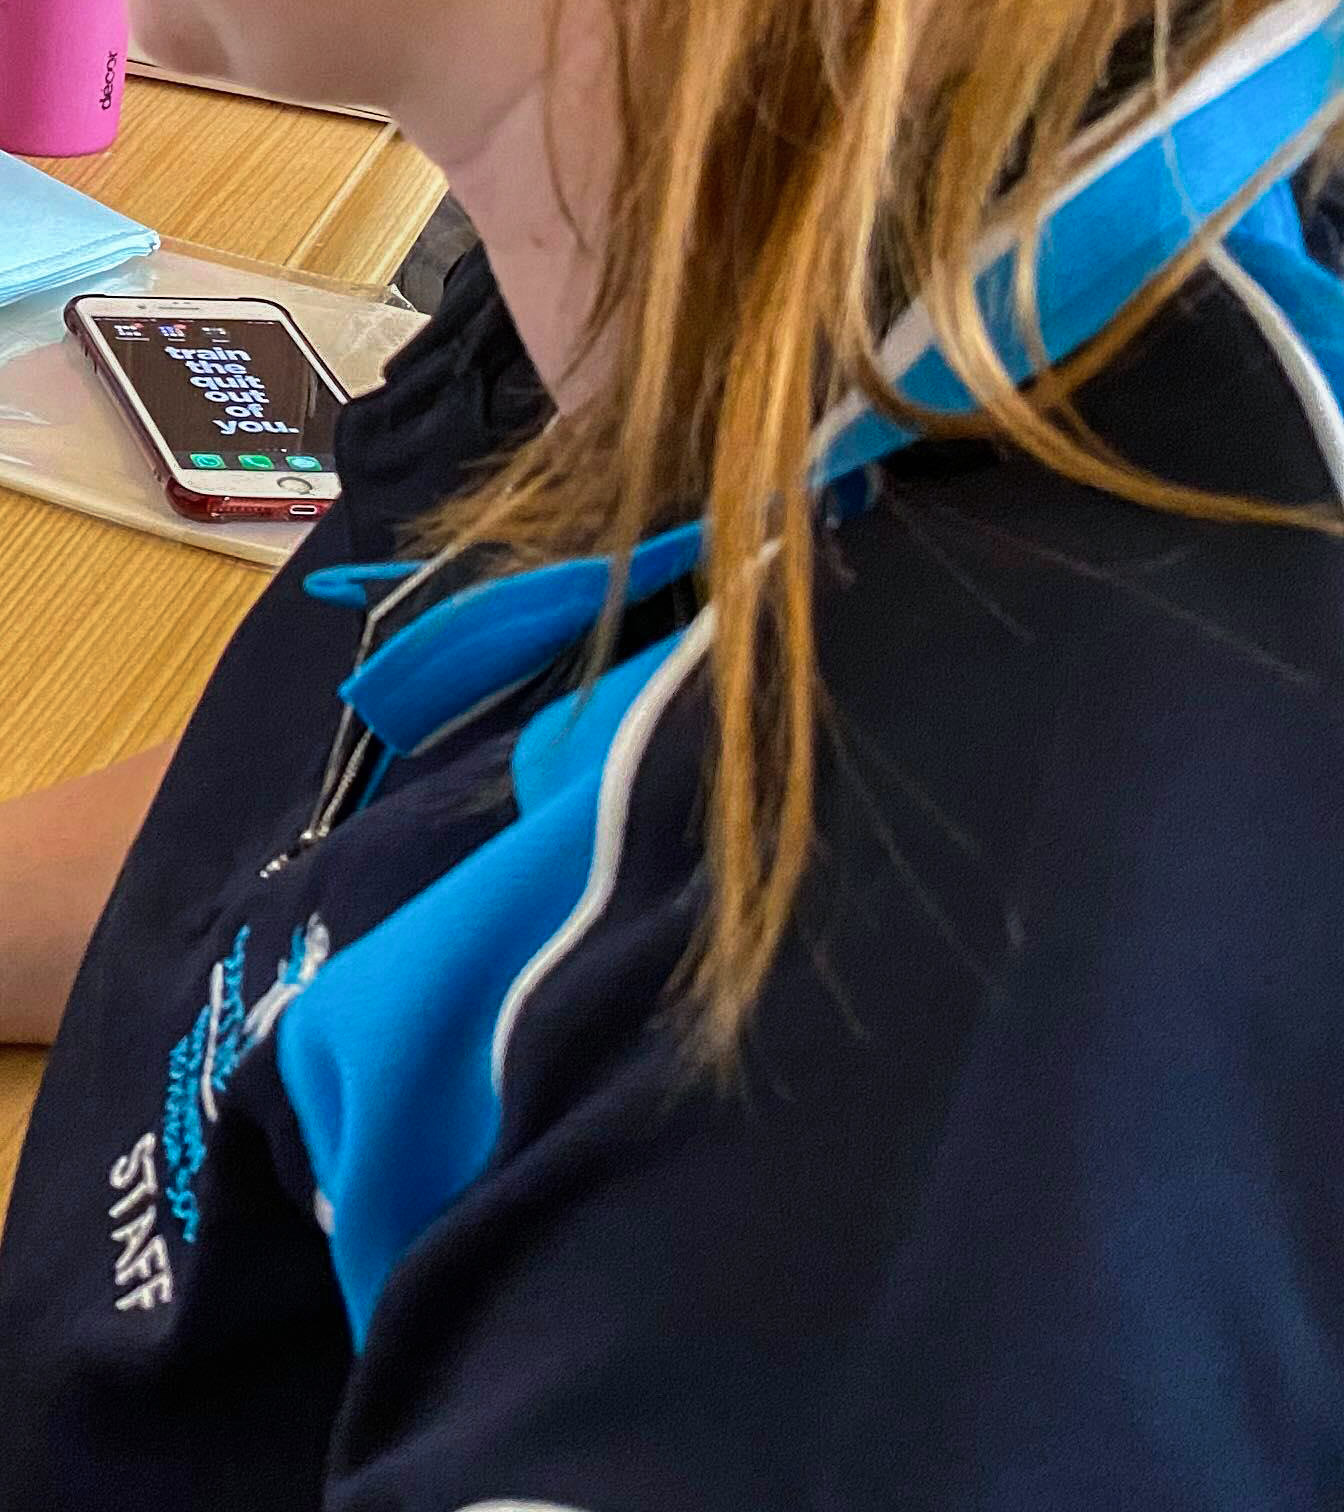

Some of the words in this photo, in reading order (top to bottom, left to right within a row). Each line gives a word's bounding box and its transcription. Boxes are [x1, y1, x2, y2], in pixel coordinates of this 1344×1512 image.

[164, 346, 252, 361] train
[185, 360, 247, 374] the
[190, 374, 265, 390] quit
[204, 389, 270, 403] out
[225, 403, 264, 418] of
[212, 419, 300, 435] you.
[109, 1132, 173, 1312] STAFF
